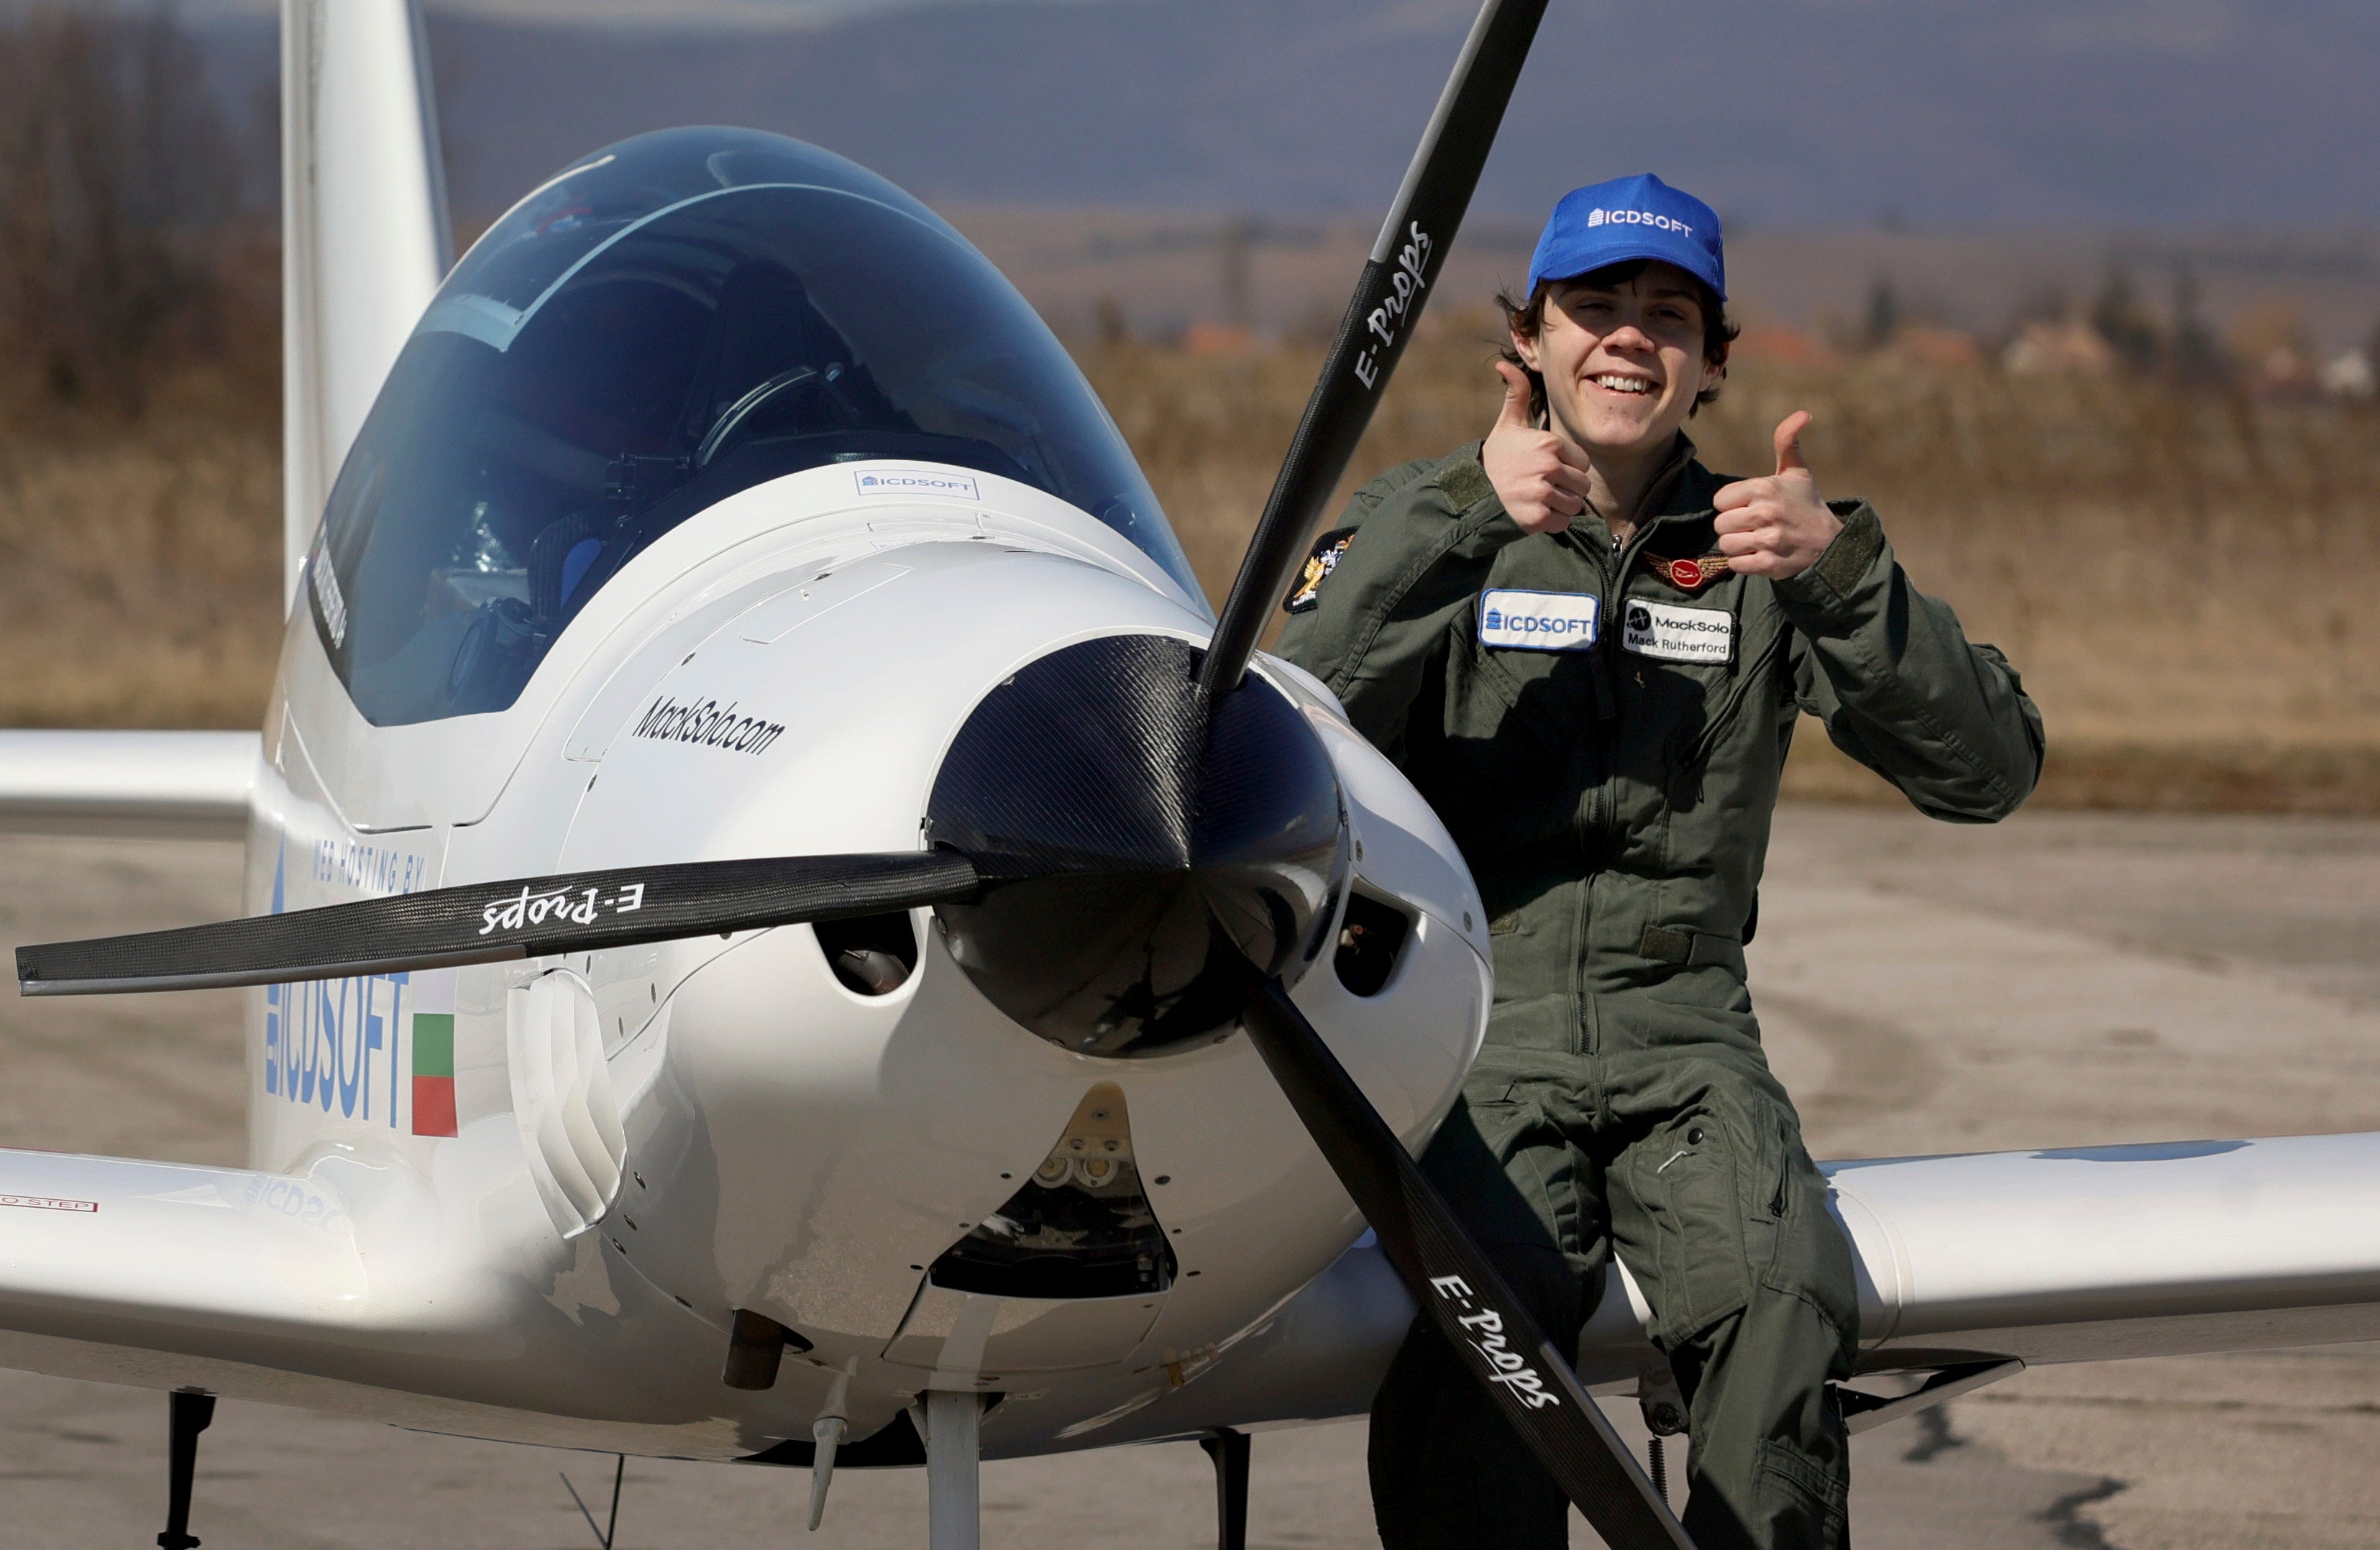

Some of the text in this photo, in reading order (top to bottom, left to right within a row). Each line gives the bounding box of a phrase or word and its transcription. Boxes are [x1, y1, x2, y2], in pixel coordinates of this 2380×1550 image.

[1605, 210, 1693, 238] ICDSOFT
[1355, 220, 1432, 390] E-Props
[880, 477, 971, 491] ICDSOFT
[1503, 615, 1591, 634] ICDSOFT
[1655, 616, 1729, 634] MackSolo
[1628, 633, 1727, 654] Mack Rutherford
[631, 694, 786, 756] MackSolo.com
[339, 843, 398, 894] HOSTING
[403, 854, 424, 894] BY
[478, 883, 645, 935] E-Props
[27, 1198, 89, 1209] STEP
[1429, 1275, 1560, 1410] E-Props
